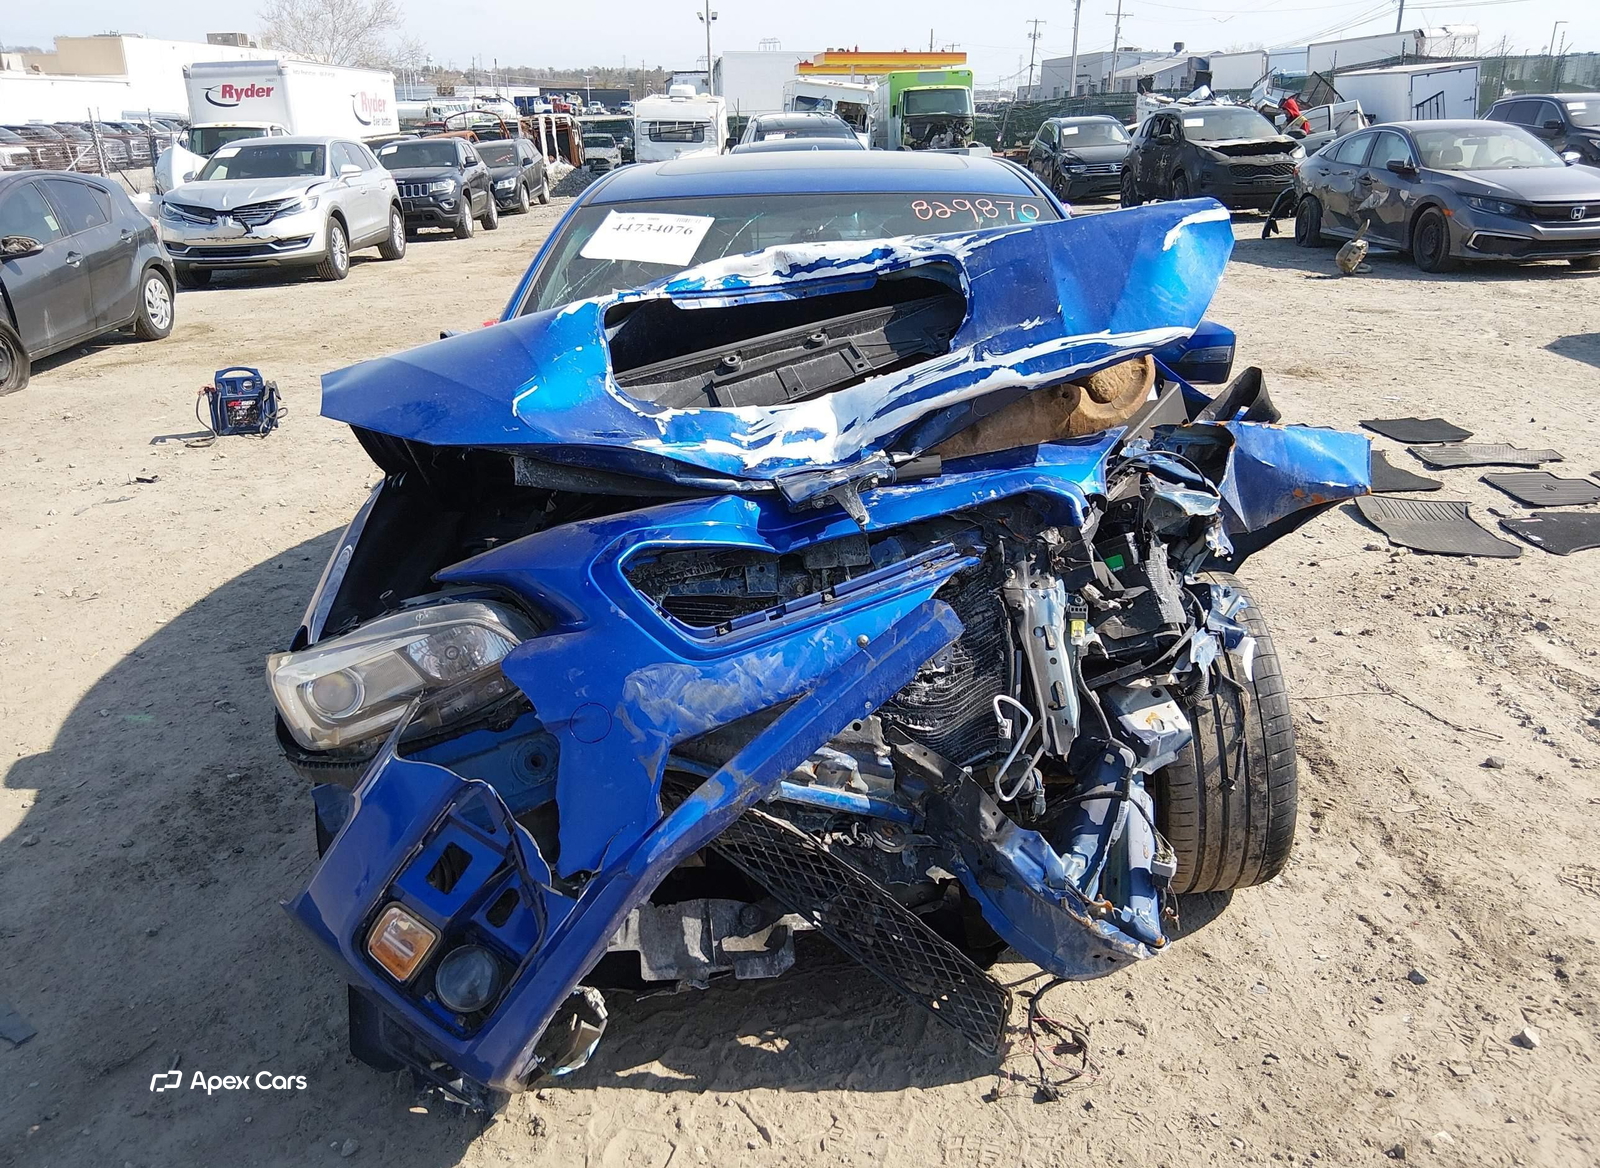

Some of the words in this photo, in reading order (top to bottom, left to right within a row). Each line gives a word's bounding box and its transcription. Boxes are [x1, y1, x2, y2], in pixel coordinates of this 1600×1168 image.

[221, 83, 275, 102] Ryder
[360, 91, 387, 118] Ryder
[911, 198, 1040, 223] 829870
[612, 223, 694, 235] 44734076
